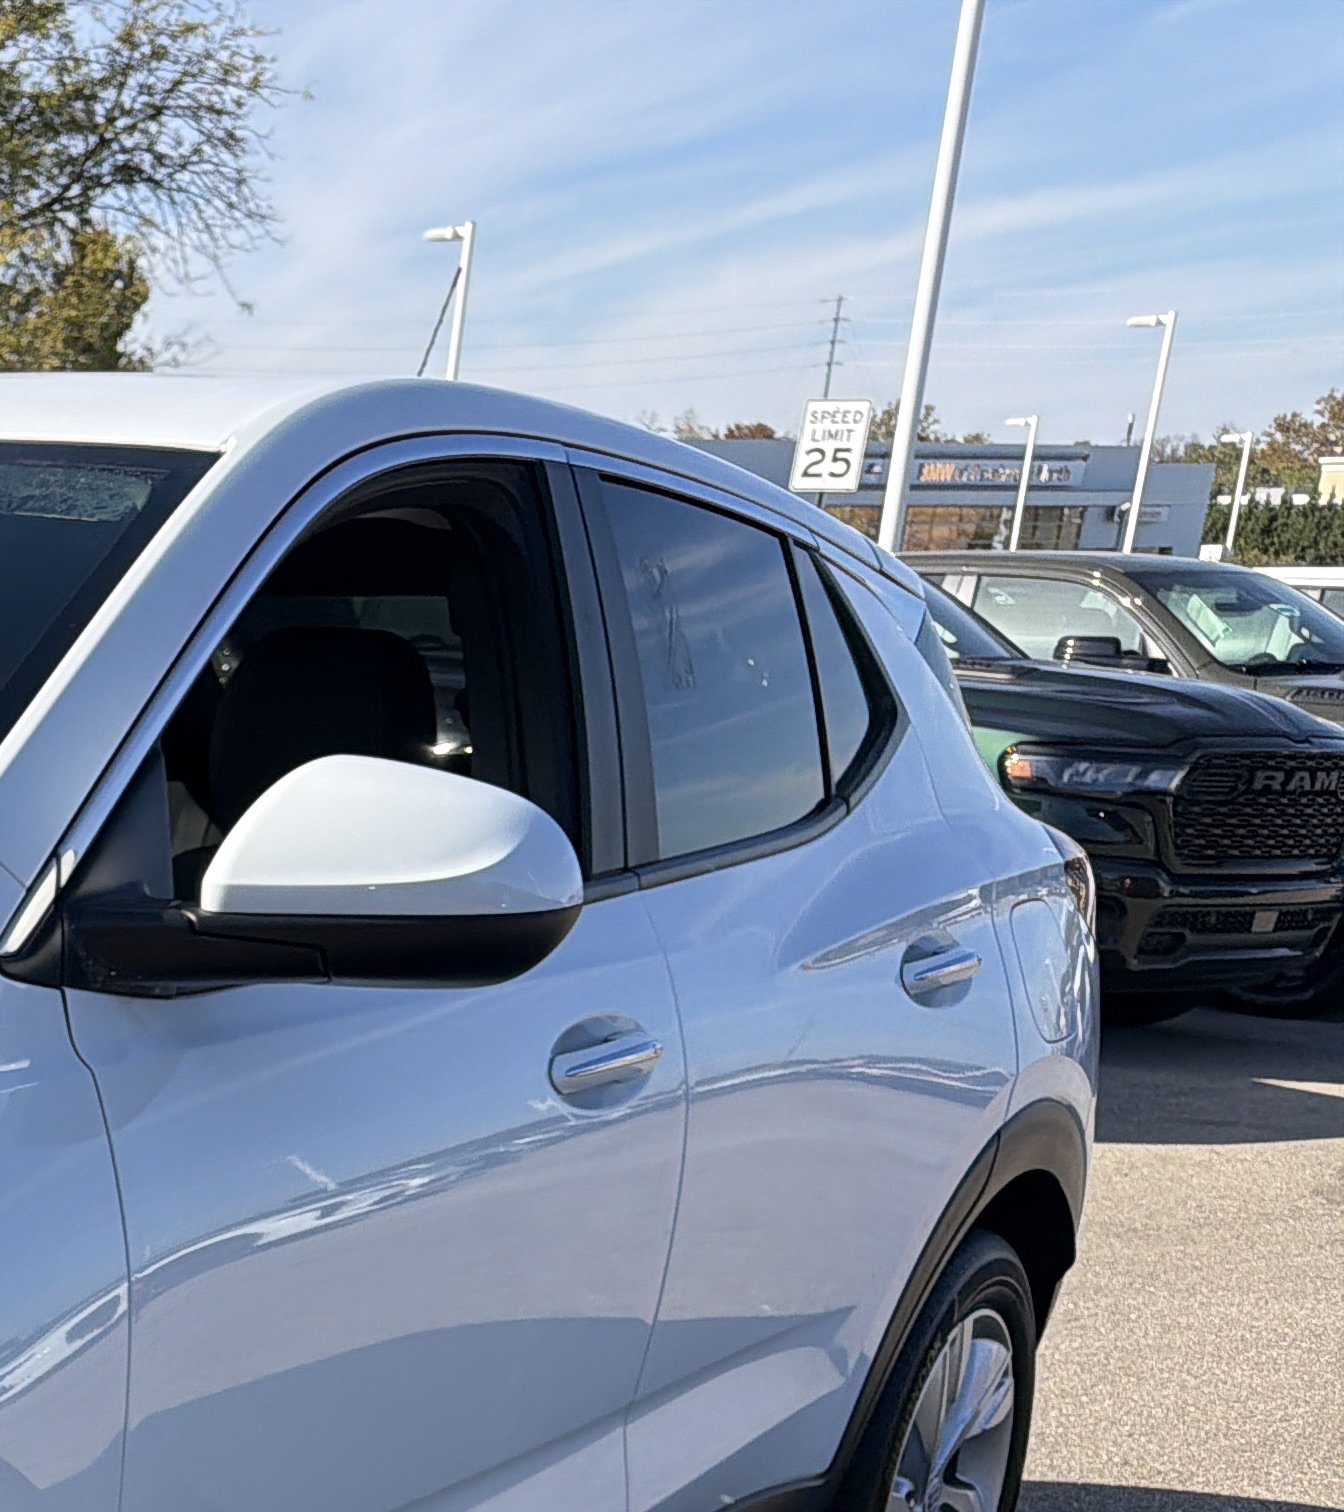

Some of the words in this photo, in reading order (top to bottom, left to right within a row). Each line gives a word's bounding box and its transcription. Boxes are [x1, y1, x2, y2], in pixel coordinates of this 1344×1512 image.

[809, 409, 864, 424] SPEED
[811, 428, 855, 442] LIMIT
[801, 448, 853, 477] 25
[1251, 769, 1340, 791] RAM
